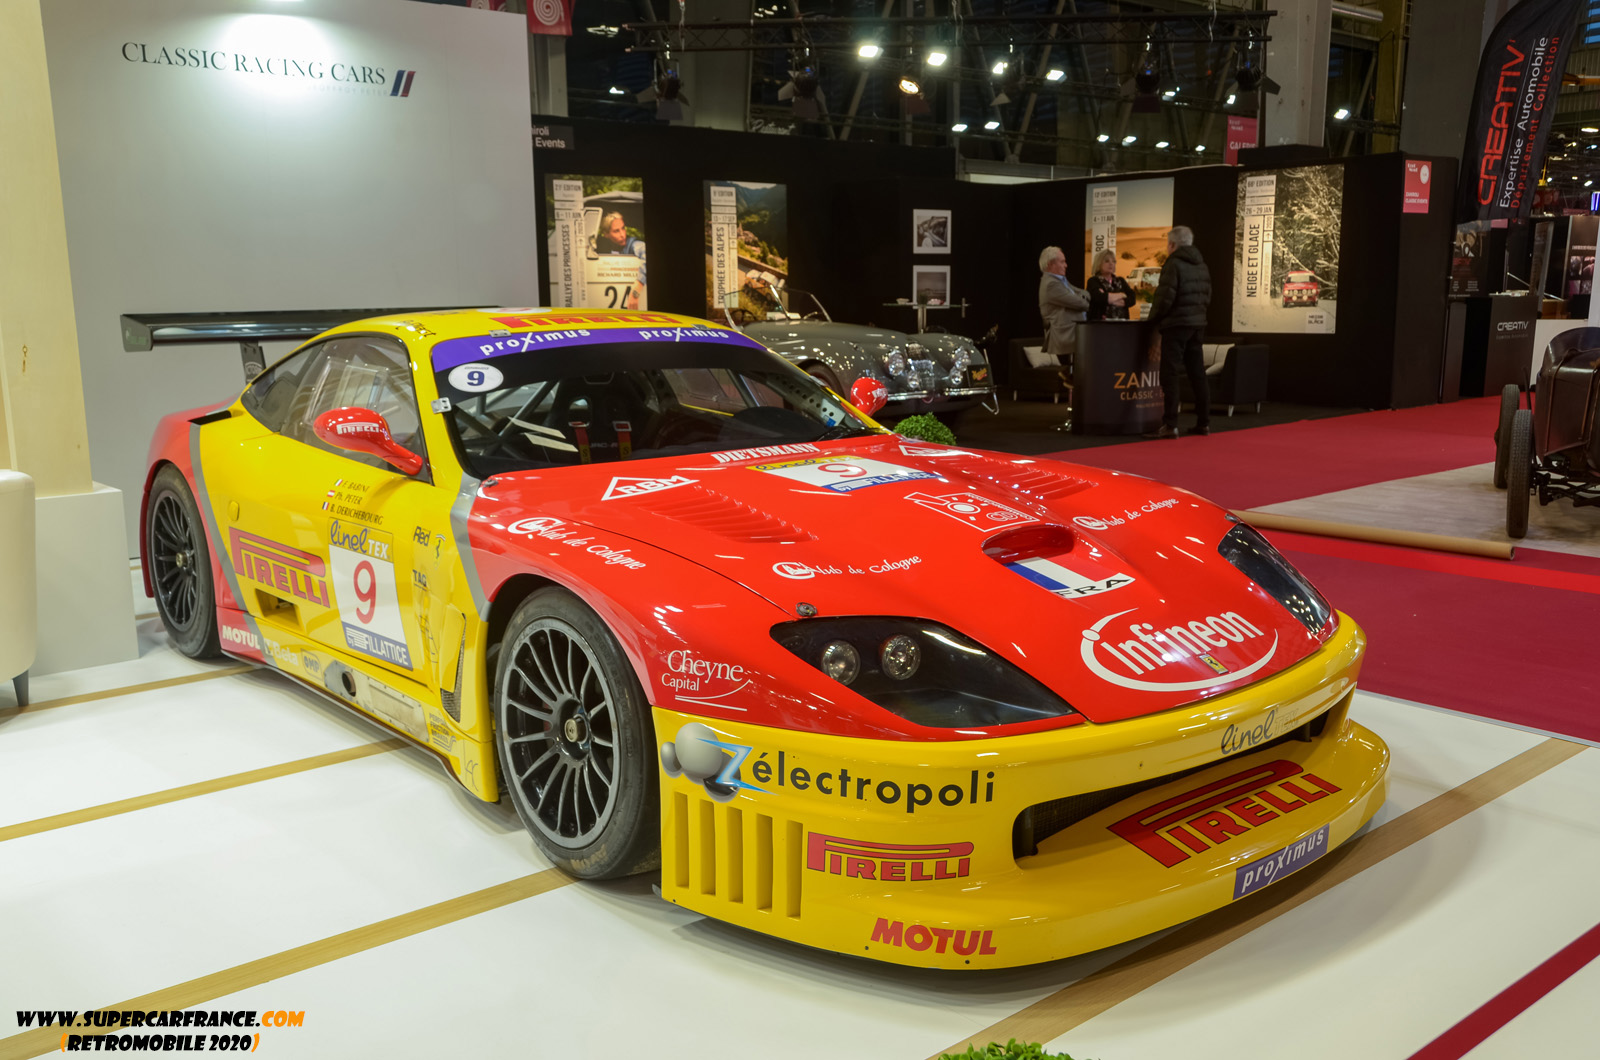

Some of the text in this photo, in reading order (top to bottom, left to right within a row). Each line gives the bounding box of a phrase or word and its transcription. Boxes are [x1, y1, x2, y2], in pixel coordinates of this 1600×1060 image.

[121, 42, 386, 85] CLASSIC RACING CARS
[1500, 37, 1549, 208] Expertise Automobile
[1510, 37, 1559, 209] Département Collection
[535, 137, 566, 149] Events
[1256, 179, 1274, 187] EDITION
[562, 224, 573, 307] RALLYE DES PRINCESSES
[716, 227, 725, 305] TROPHÉE DES ALPES
[1246, 224, 1260, 297] NEIGE ET GLACE
[489, 313, 682, 328] PIRELLI
[1497, 321, 1529, 331] CREATIV
[479, 327, 729, 356] proximus proximus
[466, 370, 485, 387] 9
[1113, 371, 1160, 389] ZANI
[1120, 390, 1154, 400] CLASSIC
[336, 421, 379, 434] PIRELLI
[711, 443, 821, 463] DIETSMANN
[817, 463, 868, 478] 9
[344, 492, 363, 505] PETER
[614, 475, 691, 495] RBM
[336, 505, 384, 526] DERICHEBOURG
[1124, 509, 1142, 520] de
[1141, 498, 1179, 513] Cologne
[562, 536, 595, 547] de
[586, 544, 646, 570] Cologne
[848, 565, 866, 575] de
[869, 554, 922, 575] Cologne
[228, 526, 331, 609] PIRELLI
[353, 560, 377, 624] 9
[222, 624, 261, 649] MOTUL
[1100, 609, 1265, 676] Infineon
[272, 641, 299, 667] Beta
[666, 650, 745, 684] Cheyne
[661, 672, 700, 693] Capital
[1220, 709, 1276, 755] linel
[752, 750, 996, 814] électropoli
[1106, 759, 1343, 869] PIRELLI
[806, 831, 975, 882] PIRELLI
[1241, 827, 1325, 893] proximus
[870, 917, 998, 956] MOTUL
